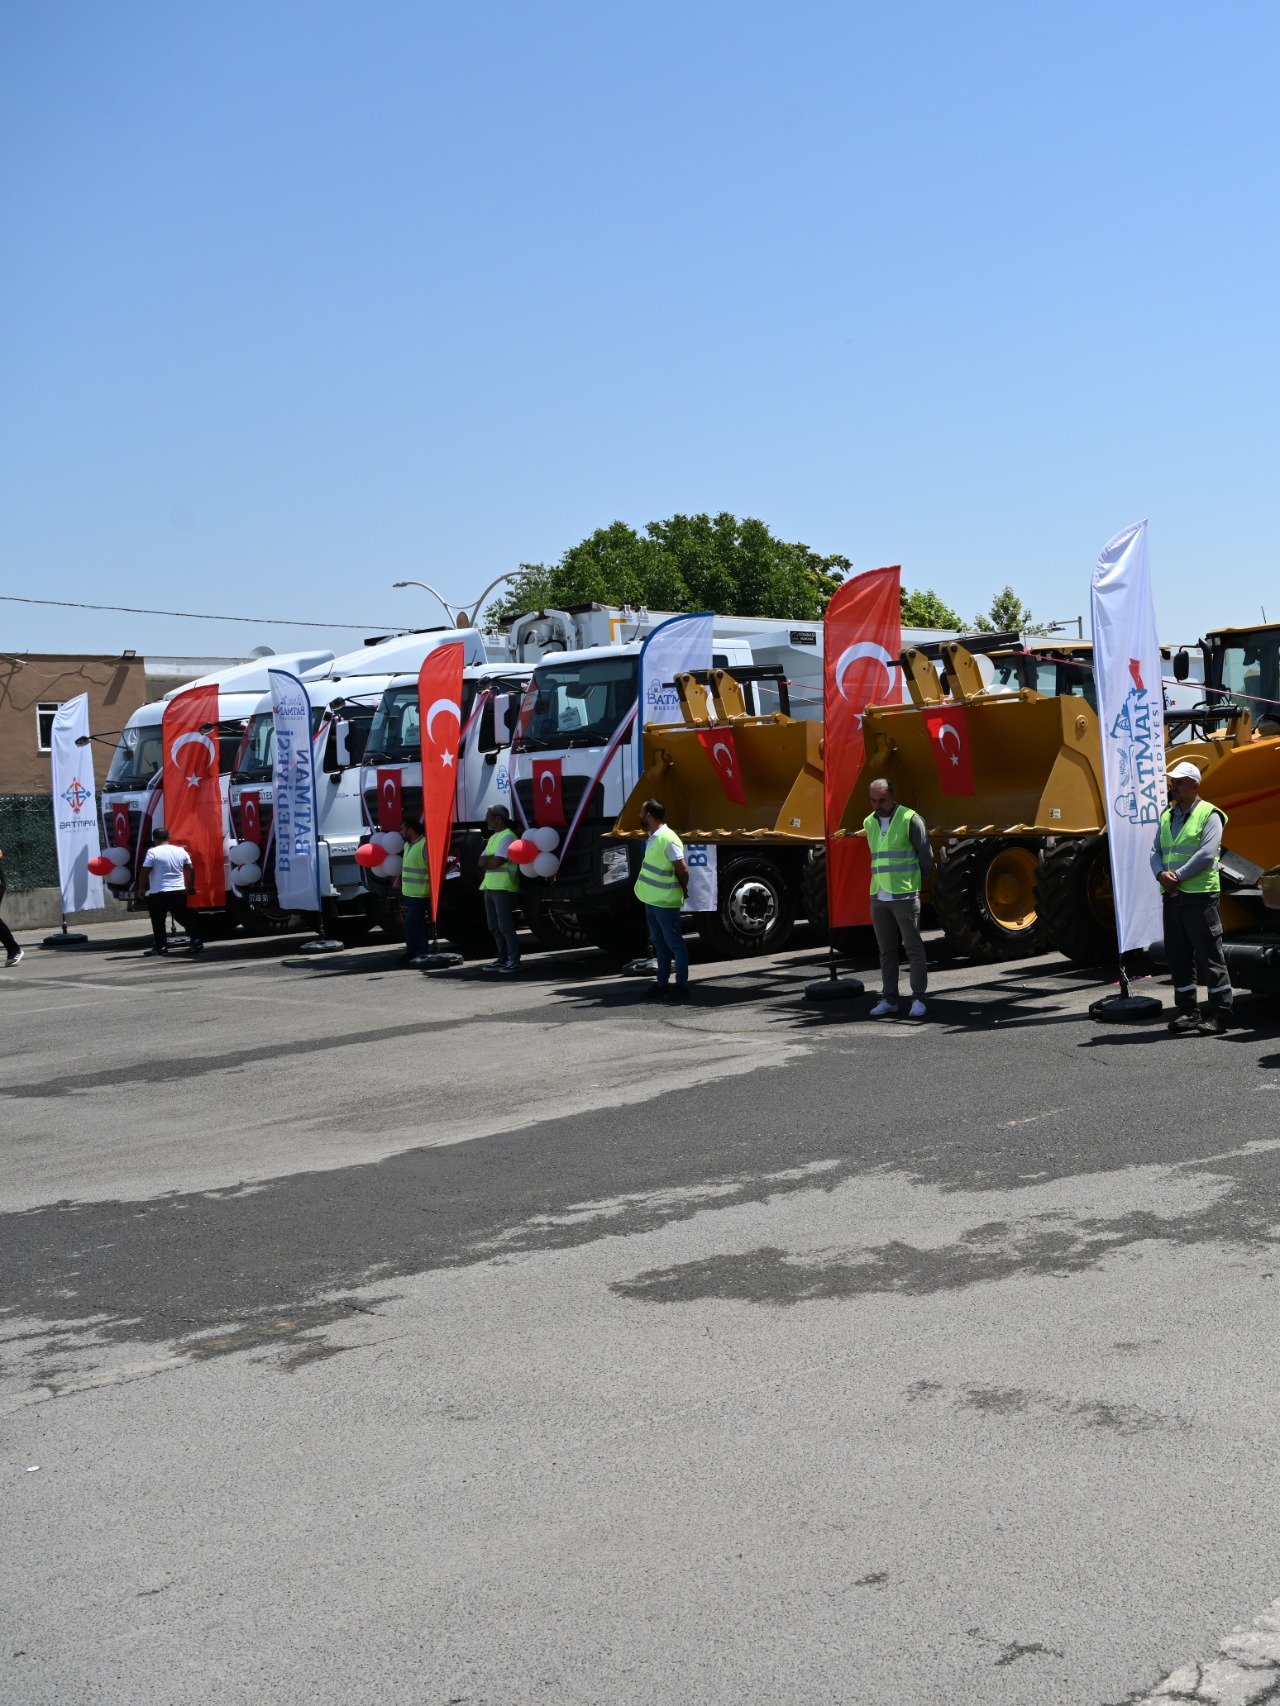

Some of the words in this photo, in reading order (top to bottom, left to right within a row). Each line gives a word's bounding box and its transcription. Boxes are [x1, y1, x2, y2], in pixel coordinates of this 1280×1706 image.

[1132, 687, 1160, 827] BATMAN
[1150, 701, 1167, 807] BELEDİYESİ
[60, 820, 96, 830] BATMAN
